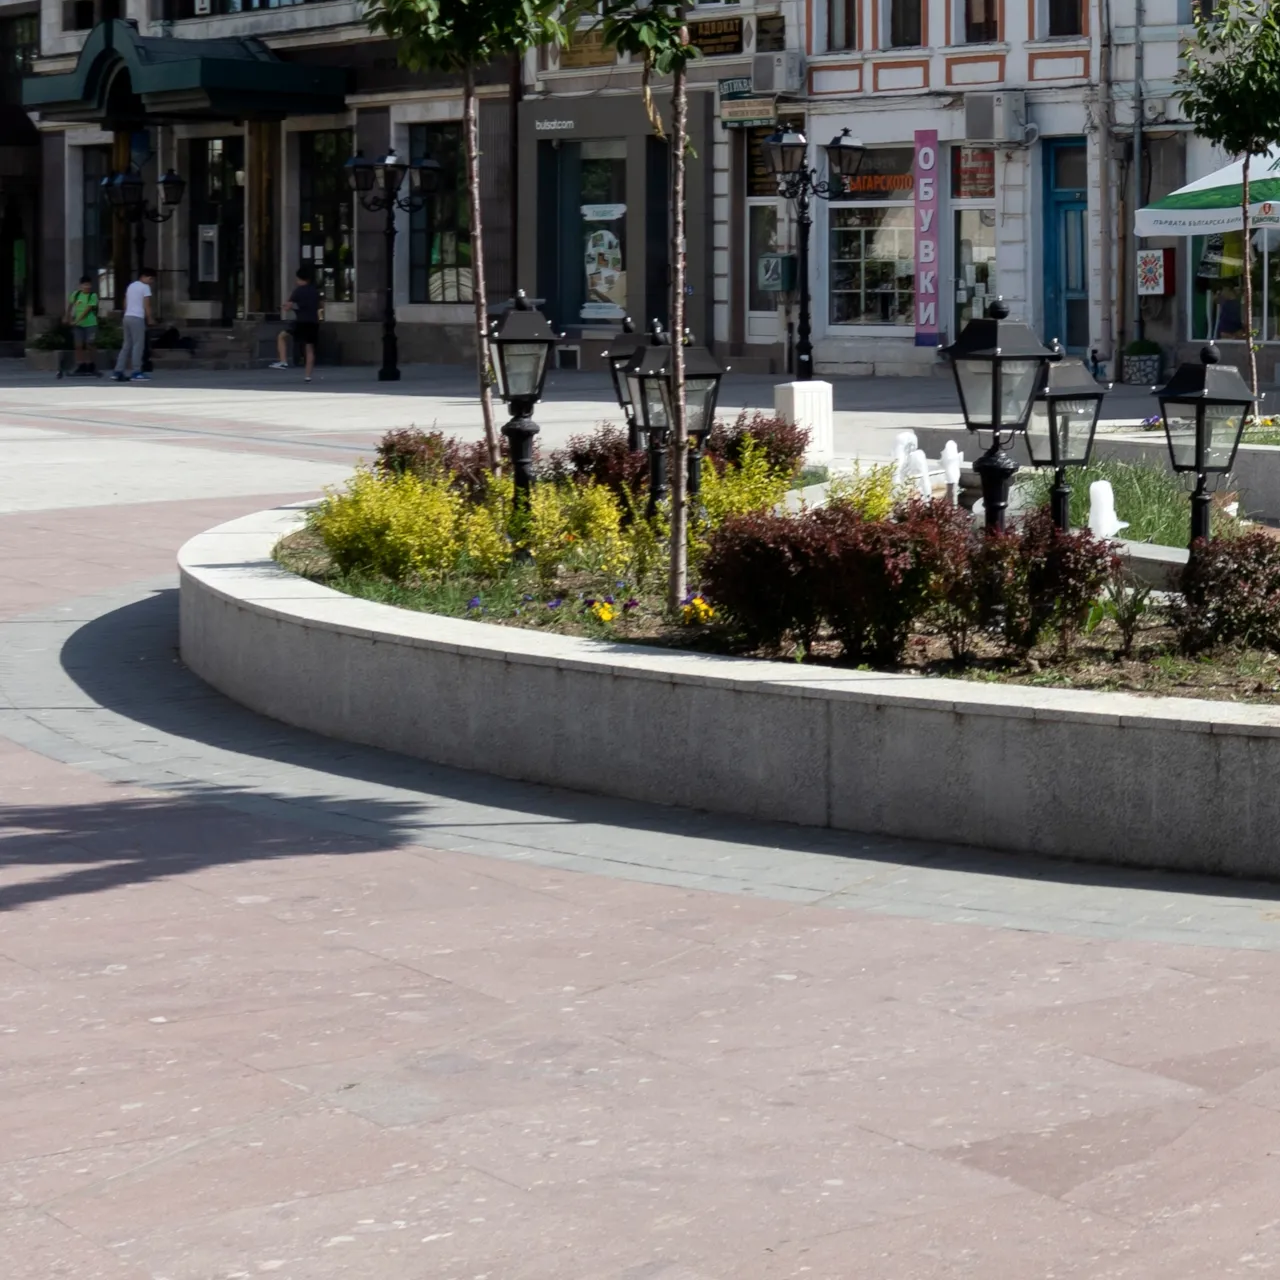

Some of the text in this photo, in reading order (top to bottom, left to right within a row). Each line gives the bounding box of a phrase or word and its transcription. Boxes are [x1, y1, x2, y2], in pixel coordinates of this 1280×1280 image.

[535, 120, 574, 130] bulsatcom
[1188, 218, 1225, 226] БЪЛГАРСКА
[918, 146, 936, 326] ОБУВКИ
